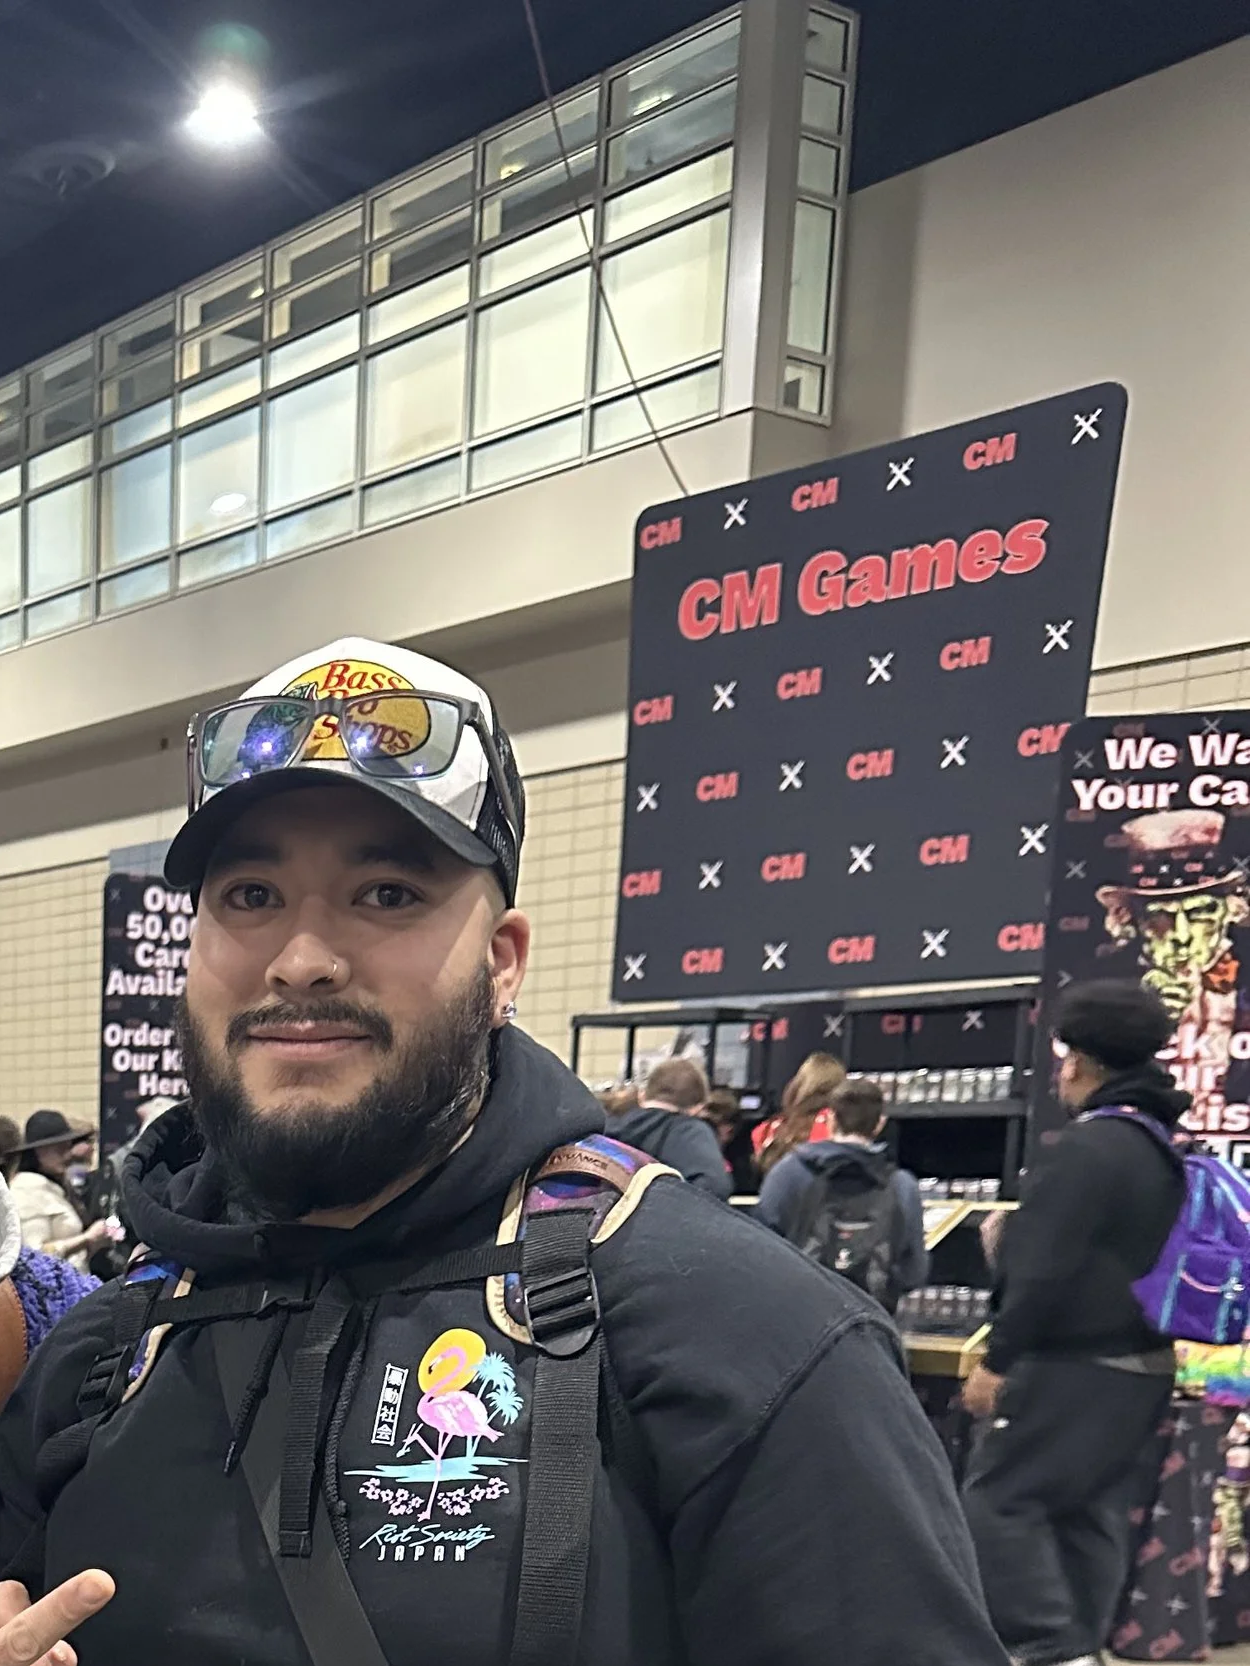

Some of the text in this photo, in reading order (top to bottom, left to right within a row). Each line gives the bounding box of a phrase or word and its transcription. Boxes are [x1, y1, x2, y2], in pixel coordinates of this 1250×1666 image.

[963, 433, 1017, 470] CM
[791, 478, 838, 512] CM
[640, 518, 682, 549] CM
[677, 518, 1050, 641] CM Games
[940, 637, 991, 670] CM
[323, 662, 402, 690] Bass
[777, 667, 822, 699] CM
[633, 696, 673, 725] CM
[846, 749, 894, 780] CM
[1104, 737, 1178, 770] We
[696, 772, 738, 801] CM
[1071, 774, 1250, 811] Your Ca
[920, 835, 970, 865] CM
[761, 853, 805, 881] CM
[622, 871, 661, 897] CM
[682, 948, 723, 974] CM
[828, 936, 876, 964] CM
[103, 1021, 175, 1048] Order
[112, 1047, 160, 1073] Our
[358, 1523, 496, 1551] Riot Society
[377, 1544, 467, 1562] JAPAN
